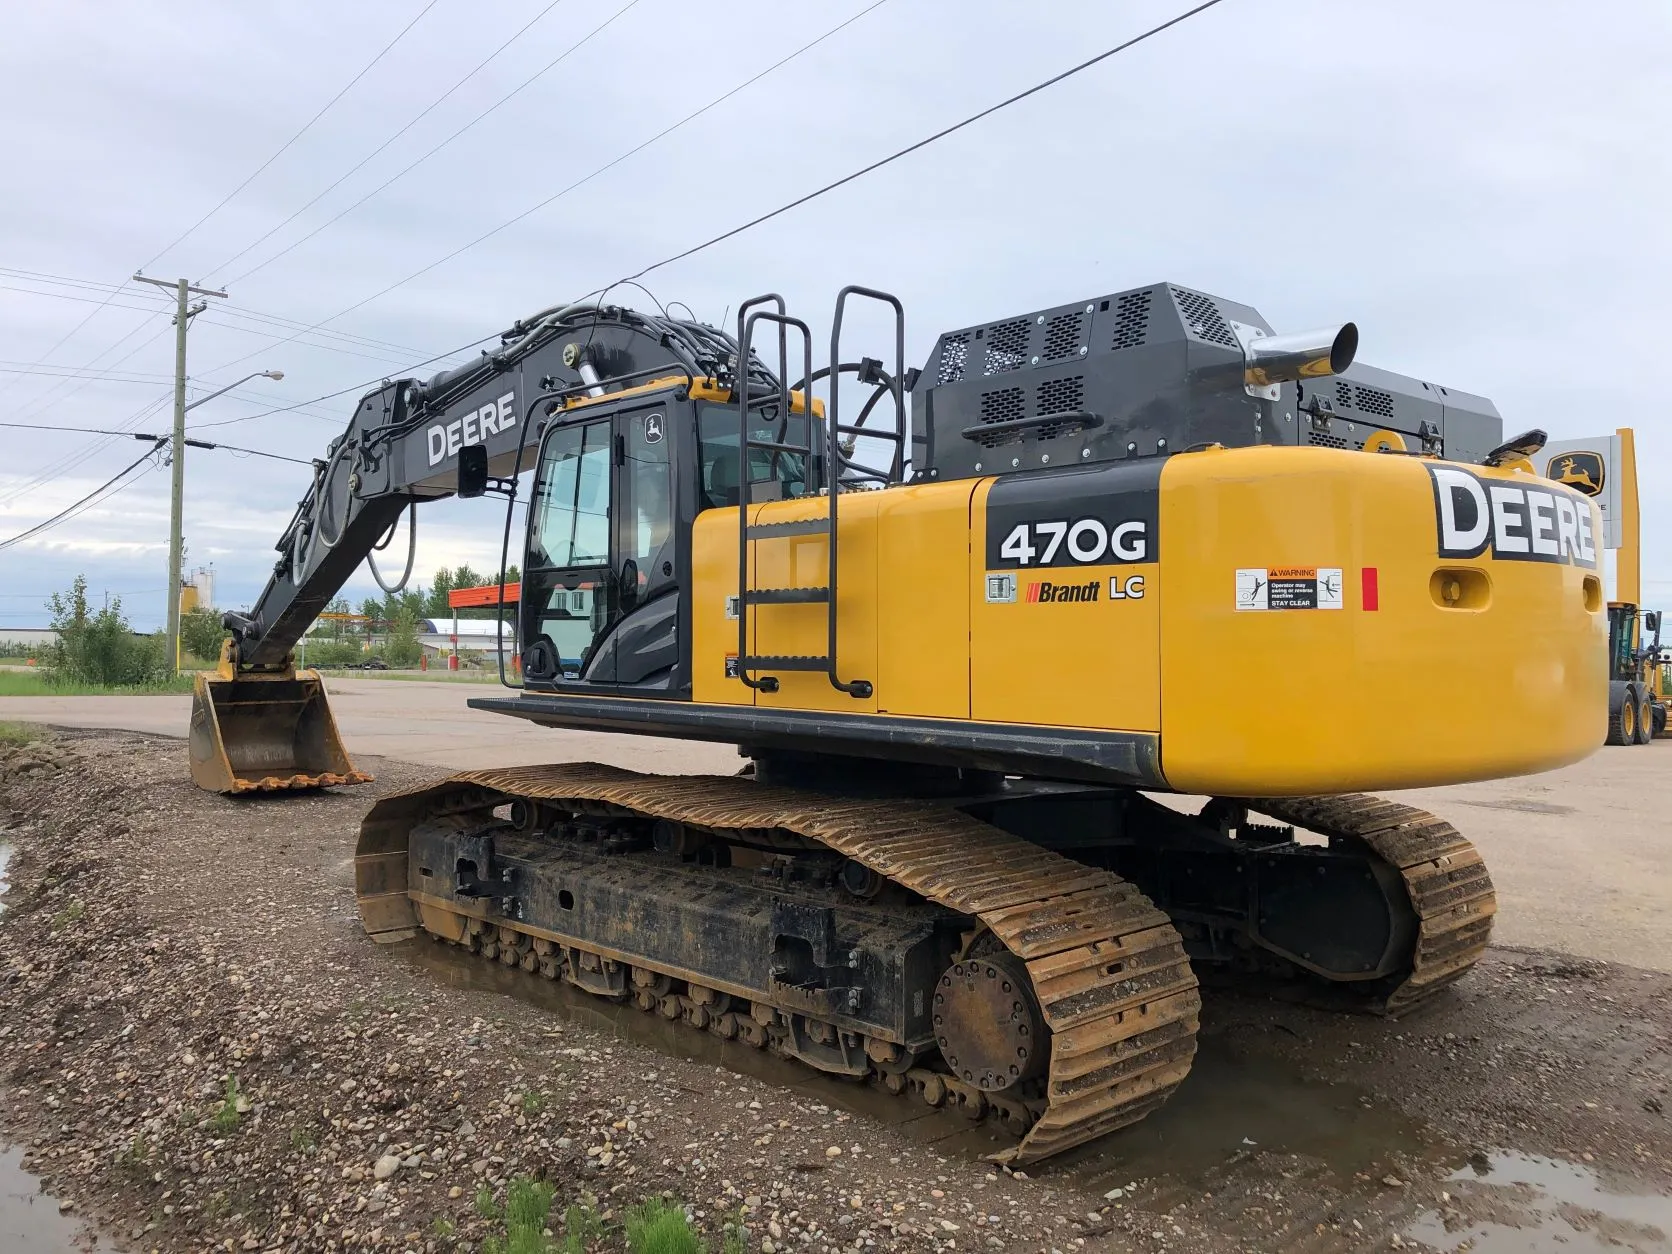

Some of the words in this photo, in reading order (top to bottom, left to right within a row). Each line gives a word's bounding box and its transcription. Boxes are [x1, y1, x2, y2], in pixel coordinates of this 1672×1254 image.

[427, 391, 516, 467] DEERE
[1431, 468, 1597, 562] DEERE
[1000, 518, 1146, 565] 470G
[1109, 576, 1145, 600] LC
[1278, 569, 1315, 577] WARNING
[1038, 581, 1101, 603] Brandt
